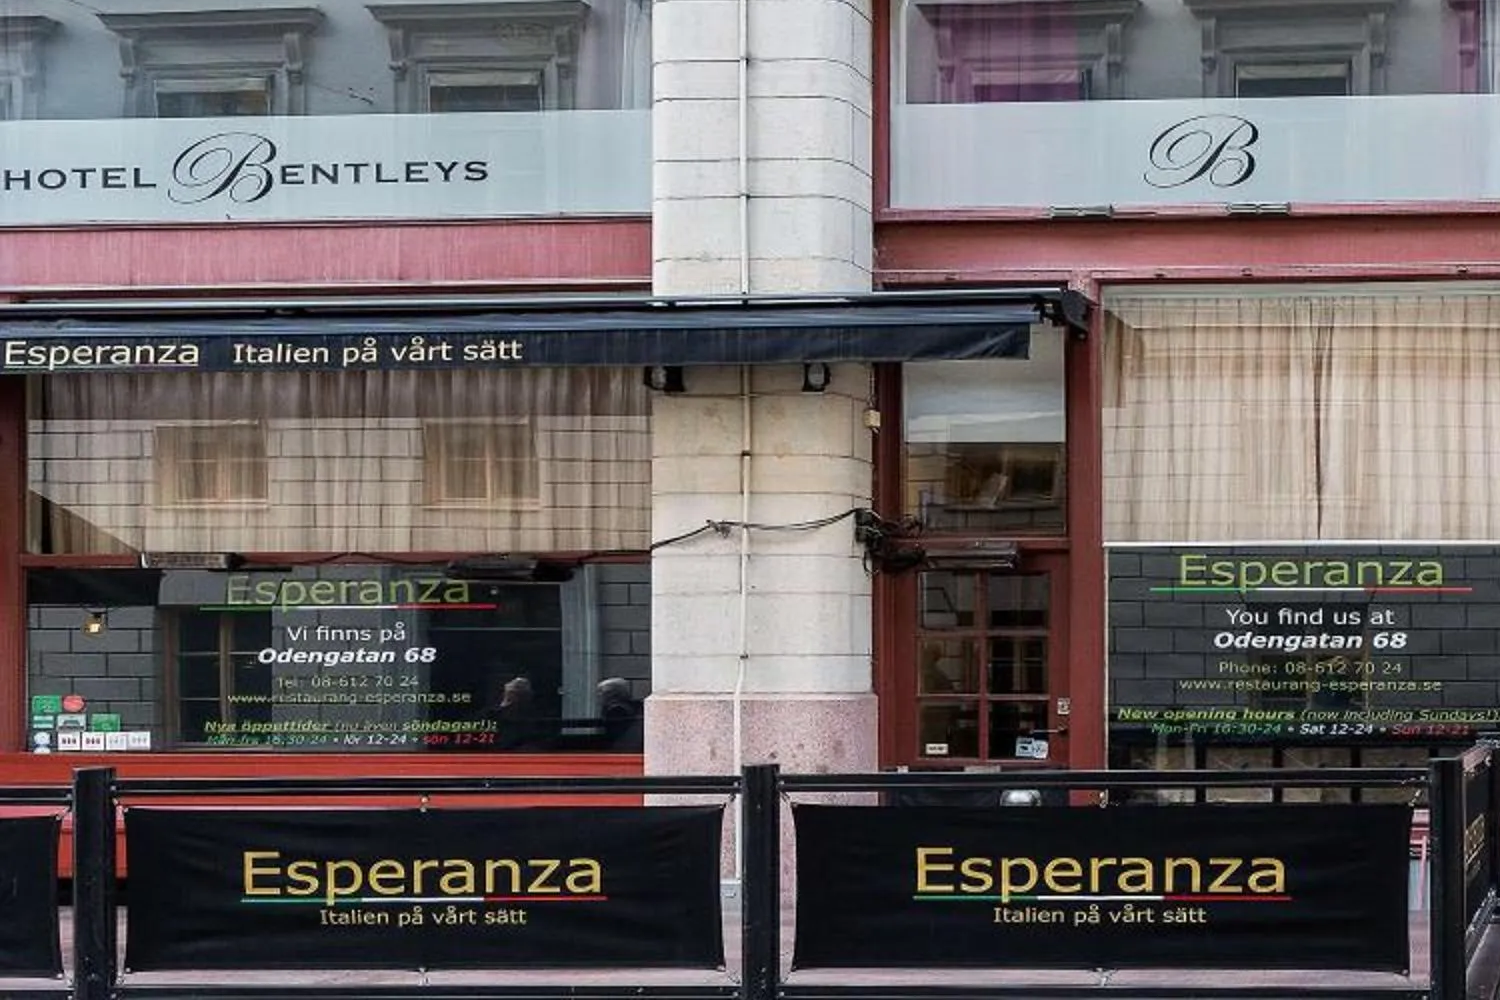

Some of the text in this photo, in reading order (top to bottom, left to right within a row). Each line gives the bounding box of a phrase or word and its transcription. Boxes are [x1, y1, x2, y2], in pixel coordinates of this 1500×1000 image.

[1143, 113, 1260, 190] B
[3, 131, 489, 204] HOTEL BENTLEYS
[3, 341, 200, 370] Esperanza
[233, 336, 524, 367] Italien på vårt sätt
[1179, 555, 1443, 593] Esperanza
[227, 576, 470, 613] Esperanza
[1226, 608, 1395, 625] You find us at
[287, 621, 406, 645] Vi finns på
[1214, 631, 1407, 652] Odengatan 68
[258, 647, 437, 667] Odengatan 68
[1219, 661, 1402, 674] Phone: 08-612 70 24
[375, 675, 393, 687] 70
[401, 675, 420, 687] 24
[1179, 680, 1442, 693] www.restaurang-esperanza.se
[1118, 708, 1158, 720] New
[1243, 708, 1295, 720] hours
[1300, 723, 1326, 735] Sat
[1330, 723, 1373, 735] 12-24
[241, 850, 604, 906] Esperanza
[915, 847, 1287, 903] Esperanza
[320, 905, 527, 928] Italien på vårt sätt
[993, 903, 1207, 926] Italien på vårt sätt
